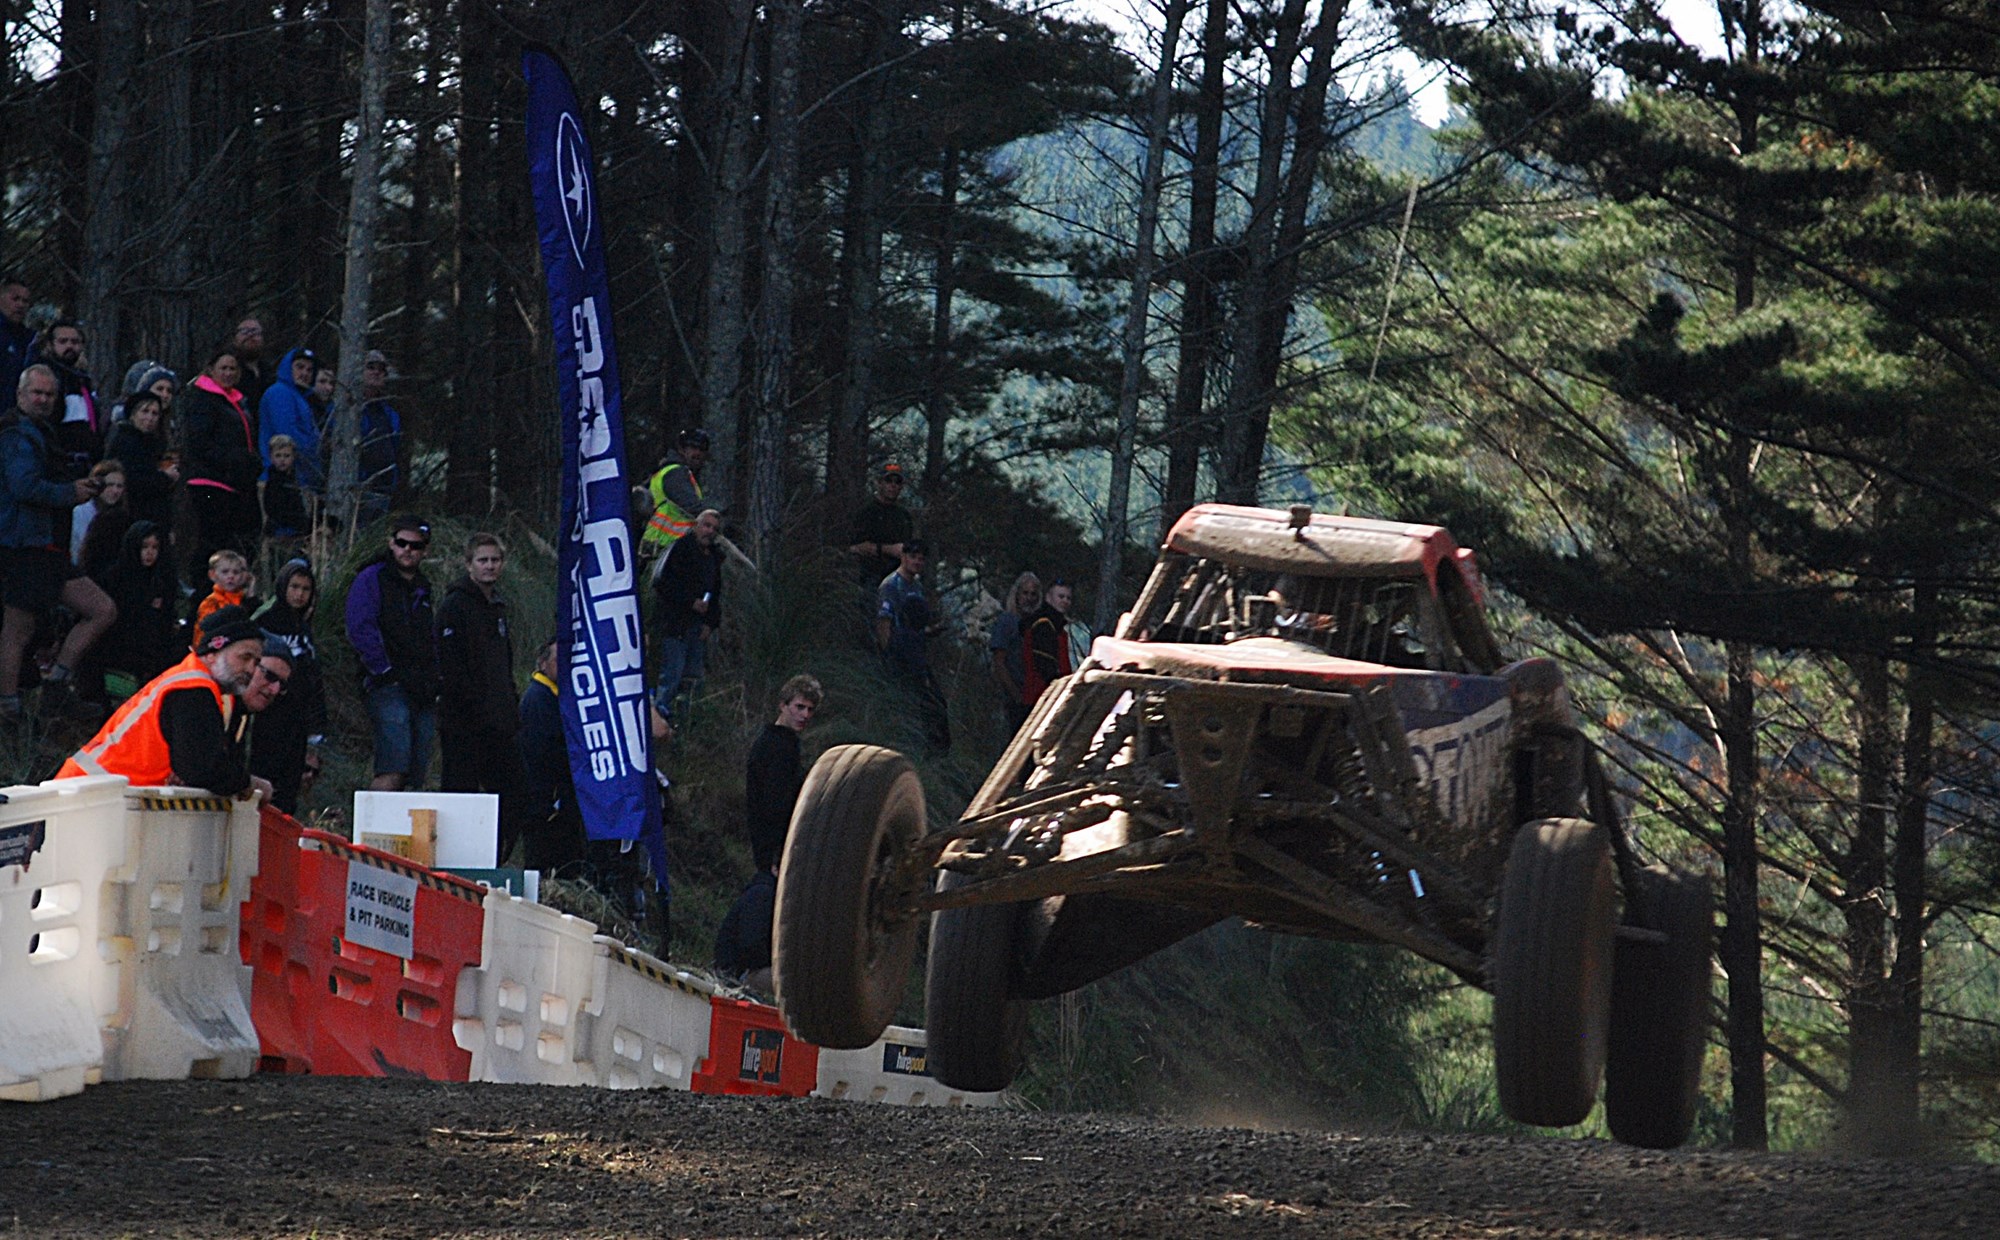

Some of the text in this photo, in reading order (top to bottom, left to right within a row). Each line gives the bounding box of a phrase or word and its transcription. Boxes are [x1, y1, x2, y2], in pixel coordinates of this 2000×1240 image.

[349, 881, 412, 913] RACE VEHICLE
[349, 907, 410, 938] & PIT PARKING
[742, 1031, 780, 1081] hirepool
[896, 1046, 927, 1075] hirepool
